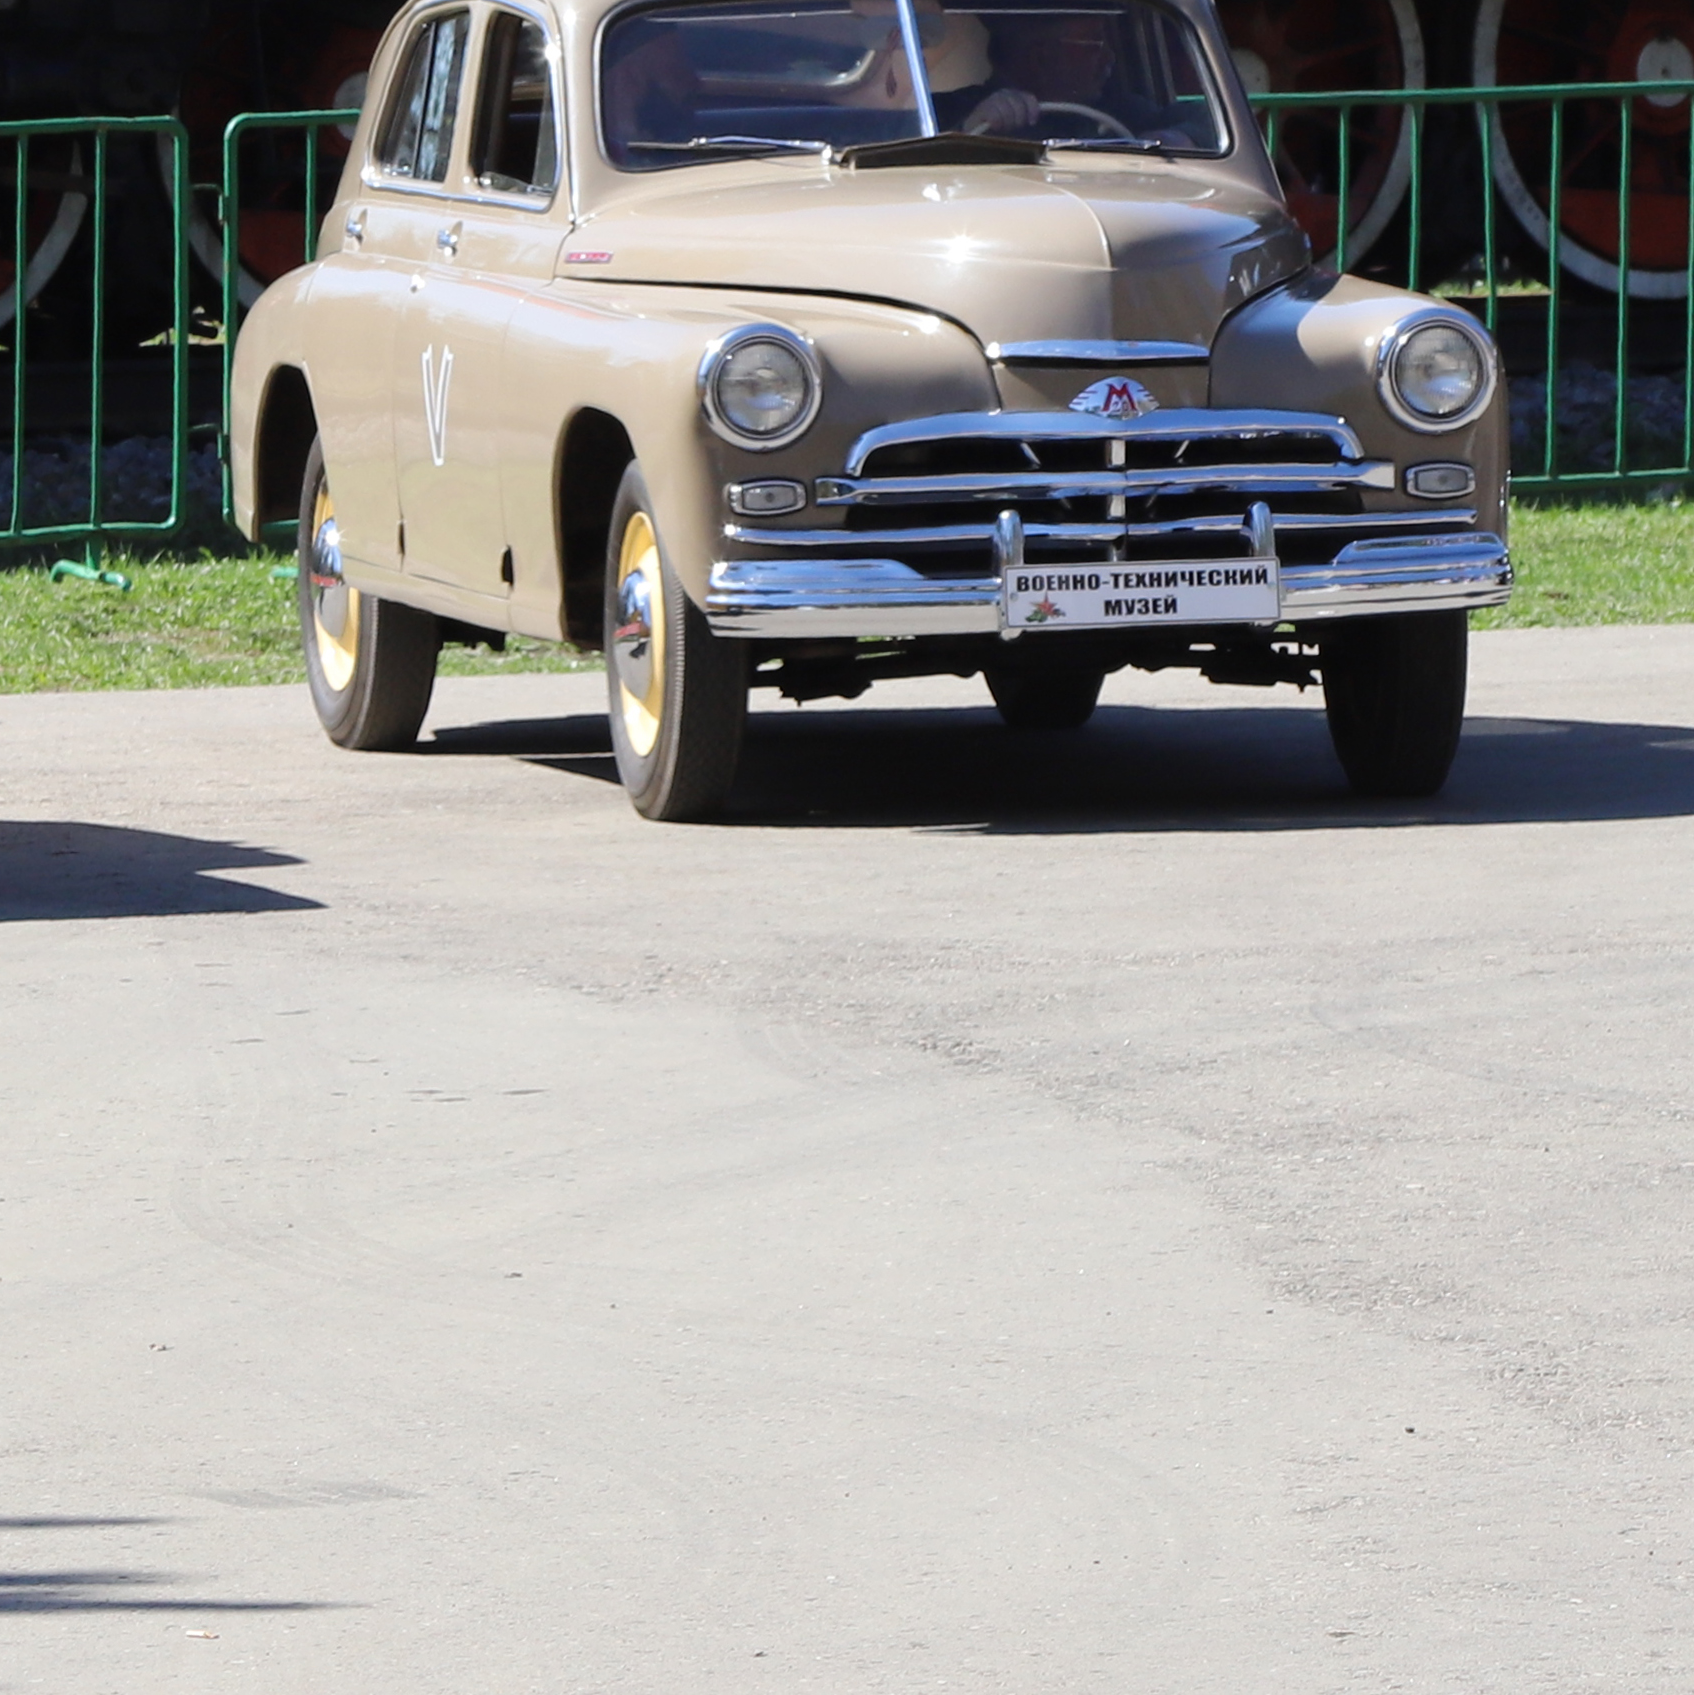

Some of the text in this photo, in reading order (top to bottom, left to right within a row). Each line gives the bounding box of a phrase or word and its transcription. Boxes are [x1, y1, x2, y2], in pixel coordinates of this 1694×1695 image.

[1101, 381, 1137, 412] М
[1016, 565, 1268, 593] ВОЕННО-ТЕХНИЧЕСКИЙ
[1104, 594, 1178, 617] МУЗЕЙ
